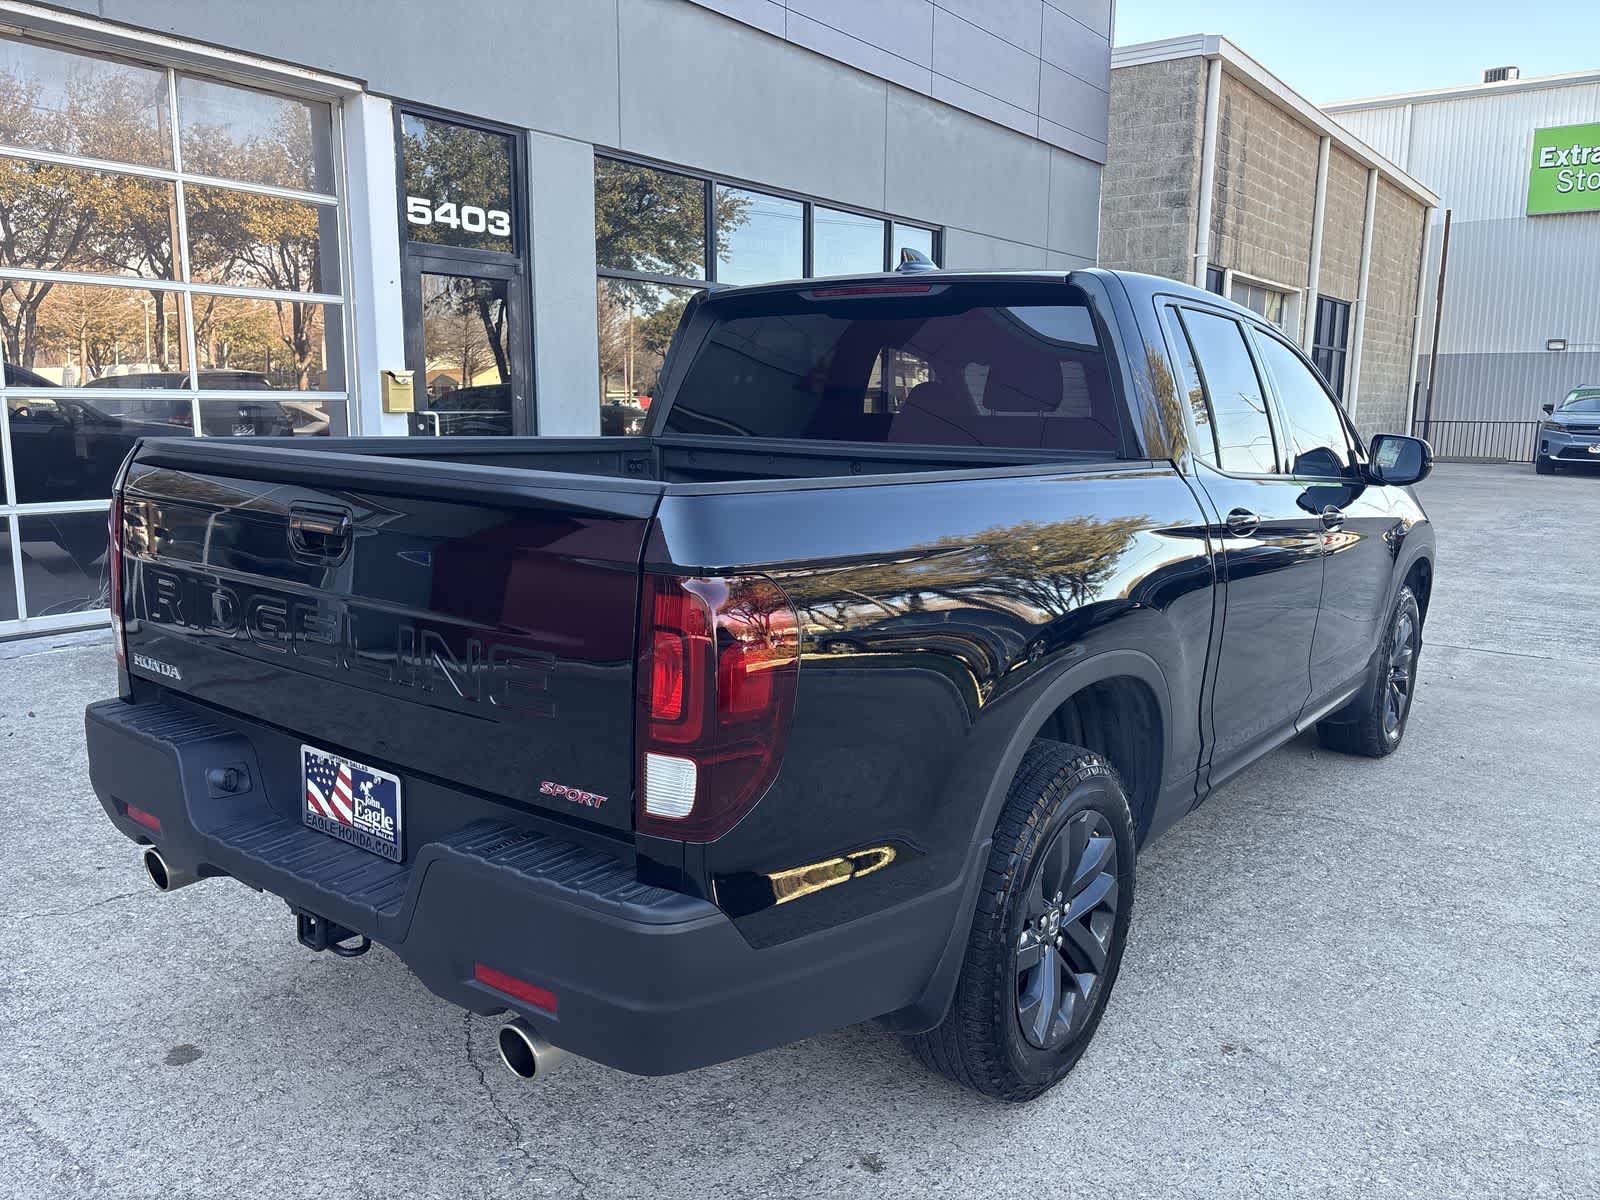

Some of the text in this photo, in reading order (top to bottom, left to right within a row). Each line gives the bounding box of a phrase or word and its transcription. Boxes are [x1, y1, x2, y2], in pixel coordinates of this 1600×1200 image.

[1539, 144, 1600, 168] Extra
[406, 196, 511, 236] 5403
[149, 567, 559, 719] RIDGELINE
[133, 653, 181, 680] HONDA
[364, 794, 380, 809] John
[540, 781, 608, 808] SPORT
[353, 797, 394, 831] Eagle
